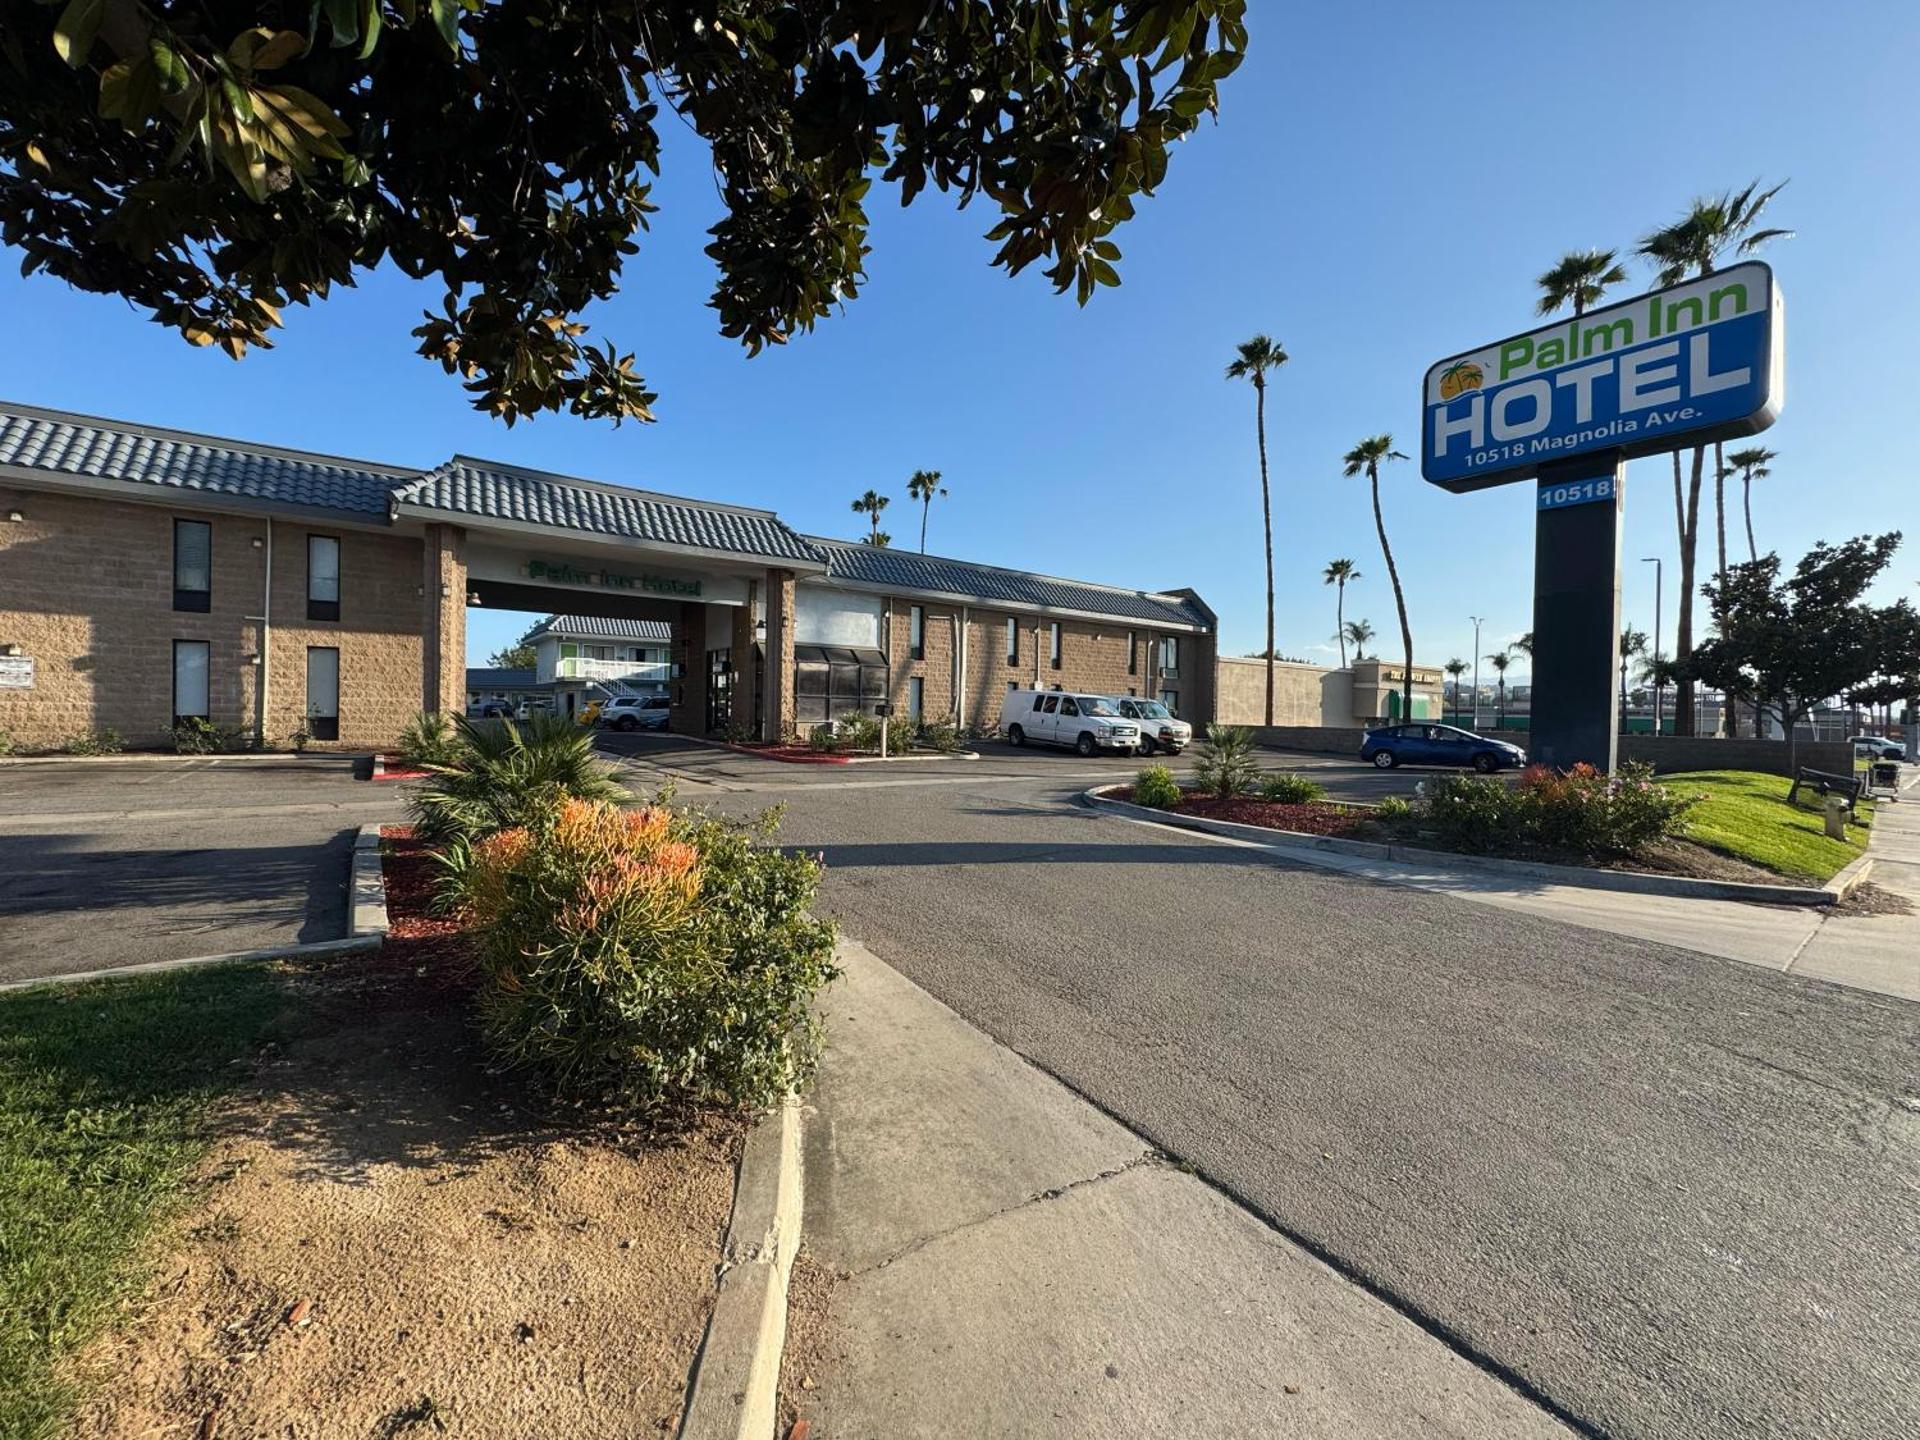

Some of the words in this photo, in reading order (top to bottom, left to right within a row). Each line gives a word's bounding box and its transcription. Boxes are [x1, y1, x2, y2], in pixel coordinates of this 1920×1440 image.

[1500, 317, 1634, 381] Palm
[1649, 282, 1748, 338] Inn
[1434, 332, 1750, 457] HOTEL
[1465, 443, 1525, 467] 10518
[1531, 420, 1638, 453] Magnolia
[1645, 406, 1703, 428] Ave.
[1541, 481, 1610, 505] 10518
[529, 559, 590, 585] Palm
